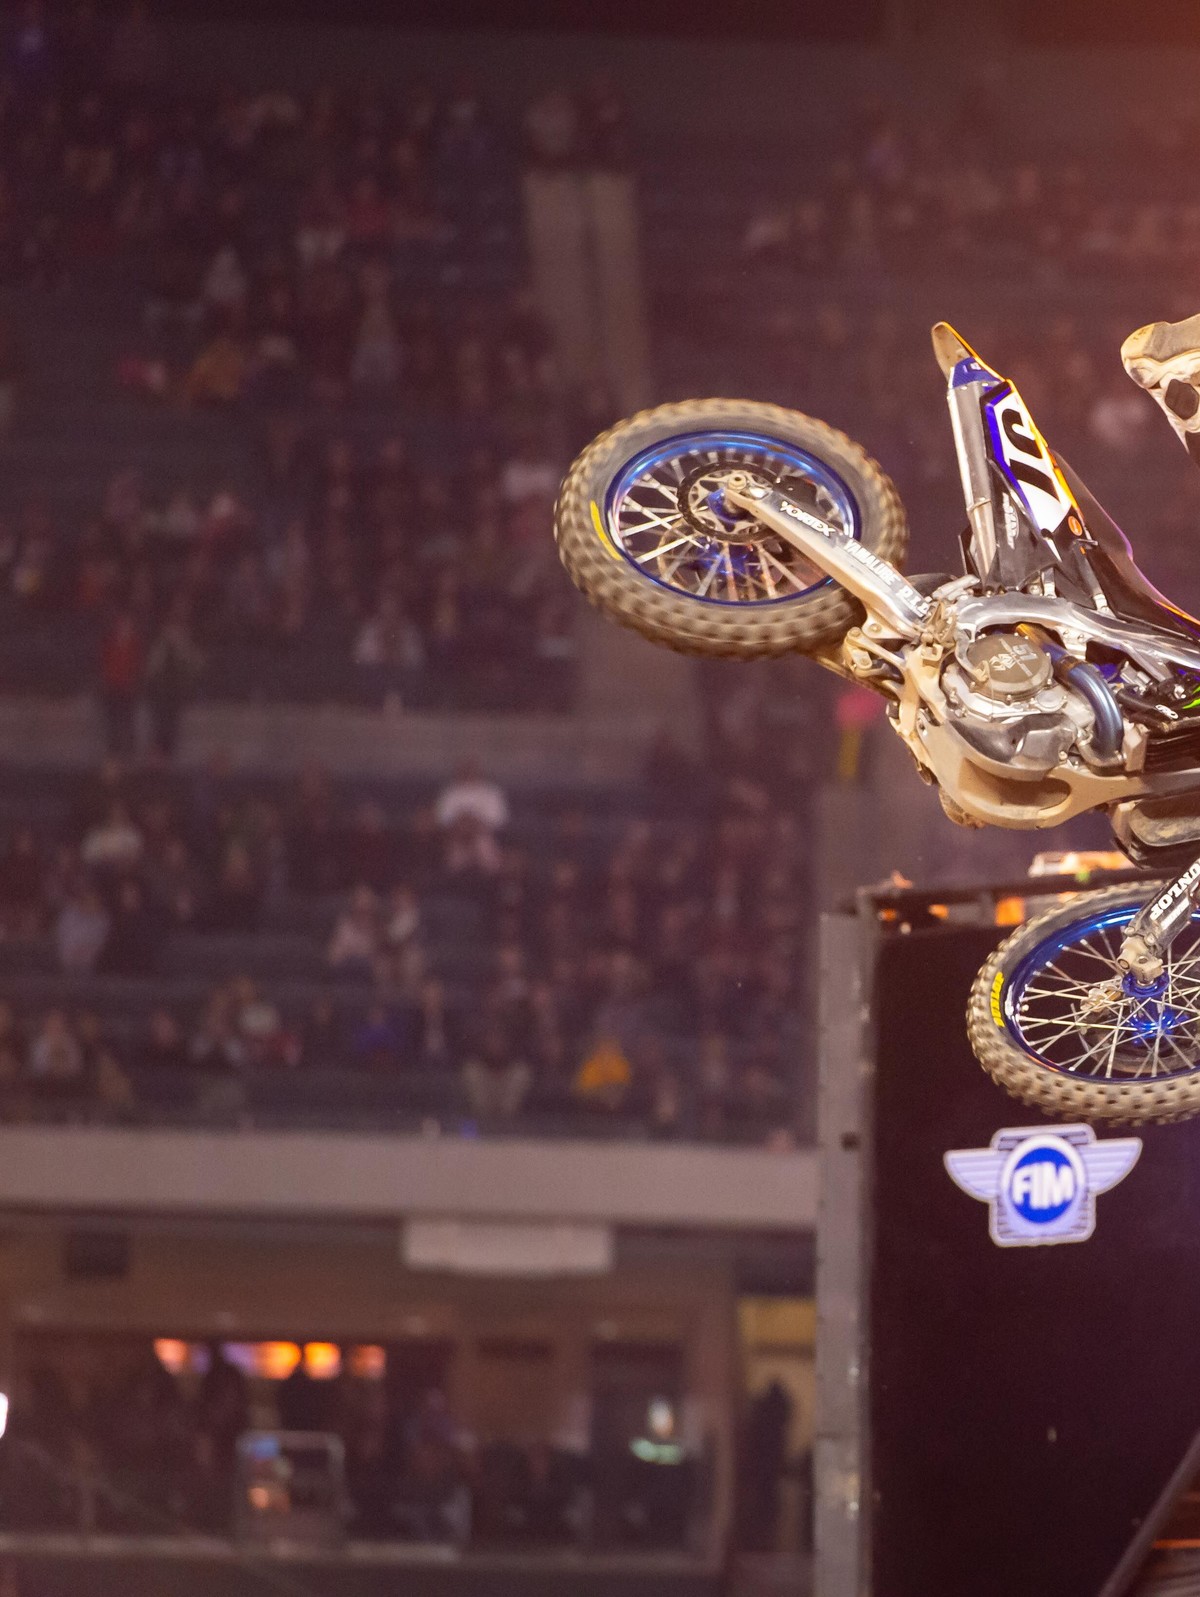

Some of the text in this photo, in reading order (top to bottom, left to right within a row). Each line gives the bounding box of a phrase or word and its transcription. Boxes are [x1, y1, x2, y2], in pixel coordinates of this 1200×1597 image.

[780, 501, 836, 537] VORTEX
[844, 538, 900, 585] YAMALUBE
[1013, 1161, 1074, 1210] FIM
